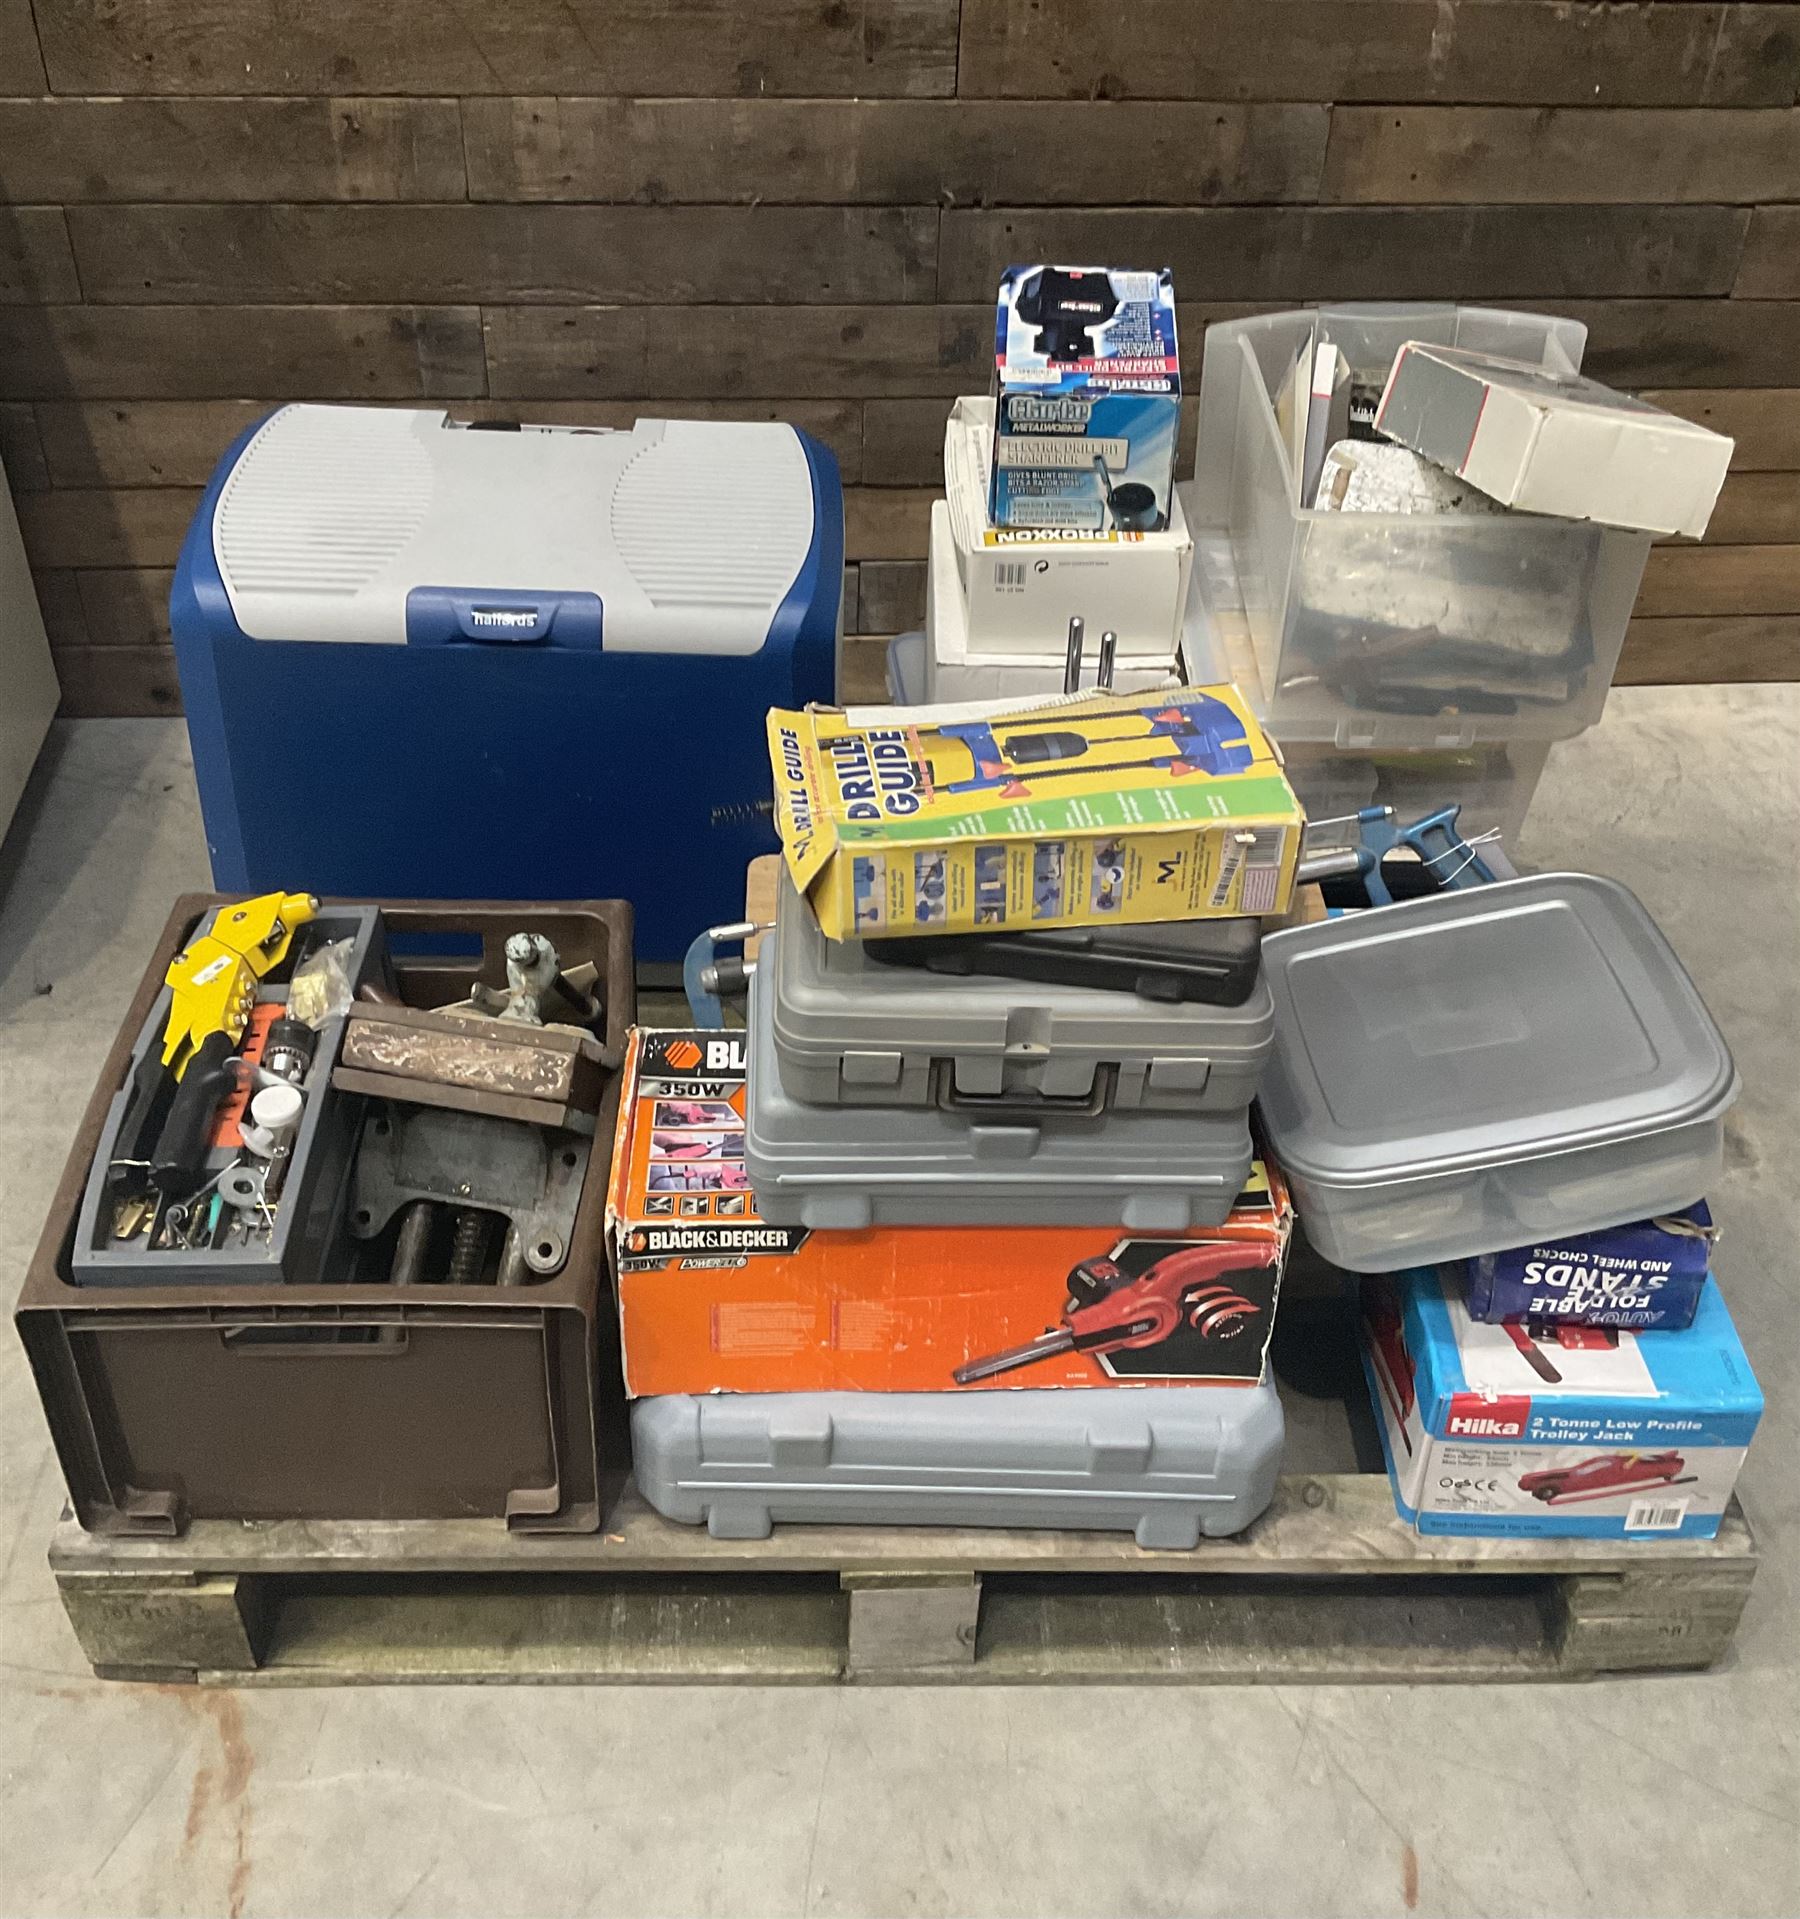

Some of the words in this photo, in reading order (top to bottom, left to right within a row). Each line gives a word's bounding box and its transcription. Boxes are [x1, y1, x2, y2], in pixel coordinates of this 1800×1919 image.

[1012, 423, 1086, 433] METALWORKER
[1007, 441, 1062, 453] ELECTRIC
[1064, 443, 1096, 455] DRILL
[1101, 444, 1119, 455] BIT
[1007, 453, 1079, 465] SHARPENER
[997, 530, 1110, 542] PROXXON
[780, 728, 804, 781] GUIDE
[832, 740, 882, 819] DRILL
[869, 730, 919, 815] GUIDE
[790, 788, 812, 832] DRILL
[707, 1041, 746, 1069] BL
[659, 1083, 724, 1097] 350W
[649, 1231, 788, 1249] BLACK&DECKER
[1533, 1248, 1588, 1263] CHOCKS
[1592, 1255, 1637, 1270] WHEEL
[1640, 1260, 1671, 1272] AND
[1523, 1262, 1668, 1291] STANDS
[1529, 1295, 1651, 1313] FOLDABLE
[1450, 1417, 1519, 1436] Hilka
[1532, 1417, 1544, 1428] 2
[1549, 1417, 1600, 1429] Tonne
[1606, 1419, 1641, 1430] Low
[1646, 1419, 1703, 1431] Profile
[1530, 1429, 1591, 1442] Trolley
[1593, 1430, 1634, 1441] Jack
